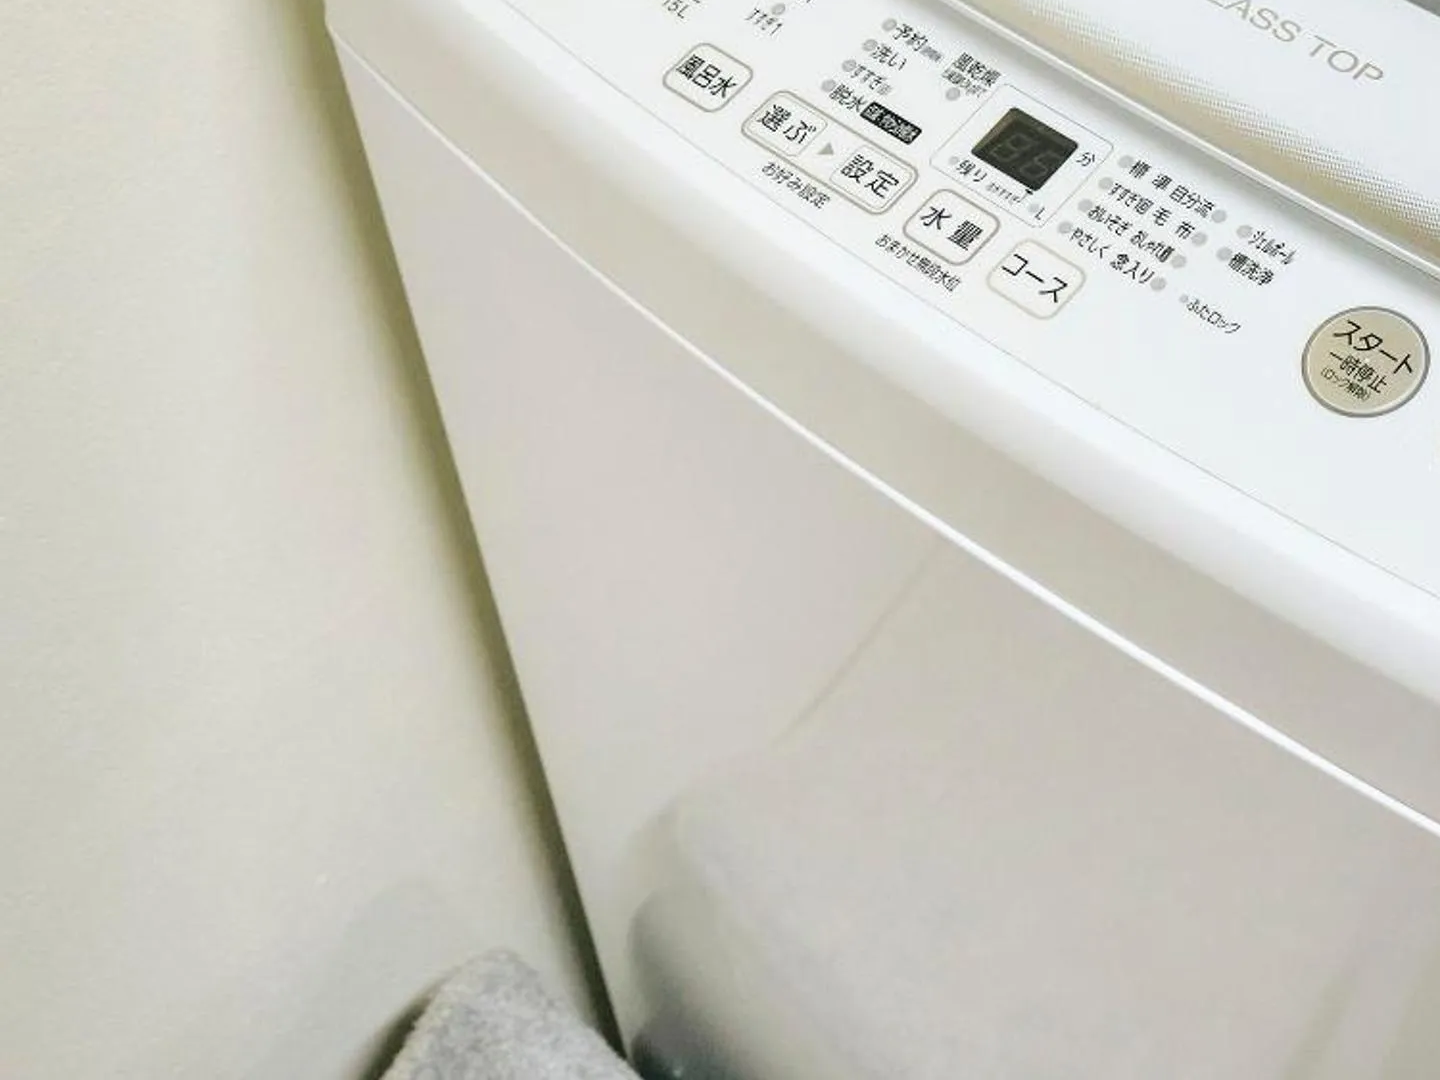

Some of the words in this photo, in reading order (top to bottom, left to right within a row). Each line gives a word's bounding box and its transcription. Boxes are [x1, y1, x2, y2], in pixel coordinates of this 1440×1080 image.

[676, 53, 737, 98] 風呂水
[1310, 34, 1385, 84] TOP
[757, 103, 817, 144] 選ぶ
[840, 153, 900, 199] 設定
[956, 159, 987, 183] 残り
[1076, 151, 1096, 168] 分
[761, 162, 831, 210] お好み設定
[919, 206, 984, 252] 水量
[1070, 227, 1113, 259] やさしく
[1001, 253, 1069, 304] コース
[1186, 299, 1242, 334] ふたロック
[1333, 320, 1414, 374] スタート
[1328, 350, 1388, 395] 一時停止
